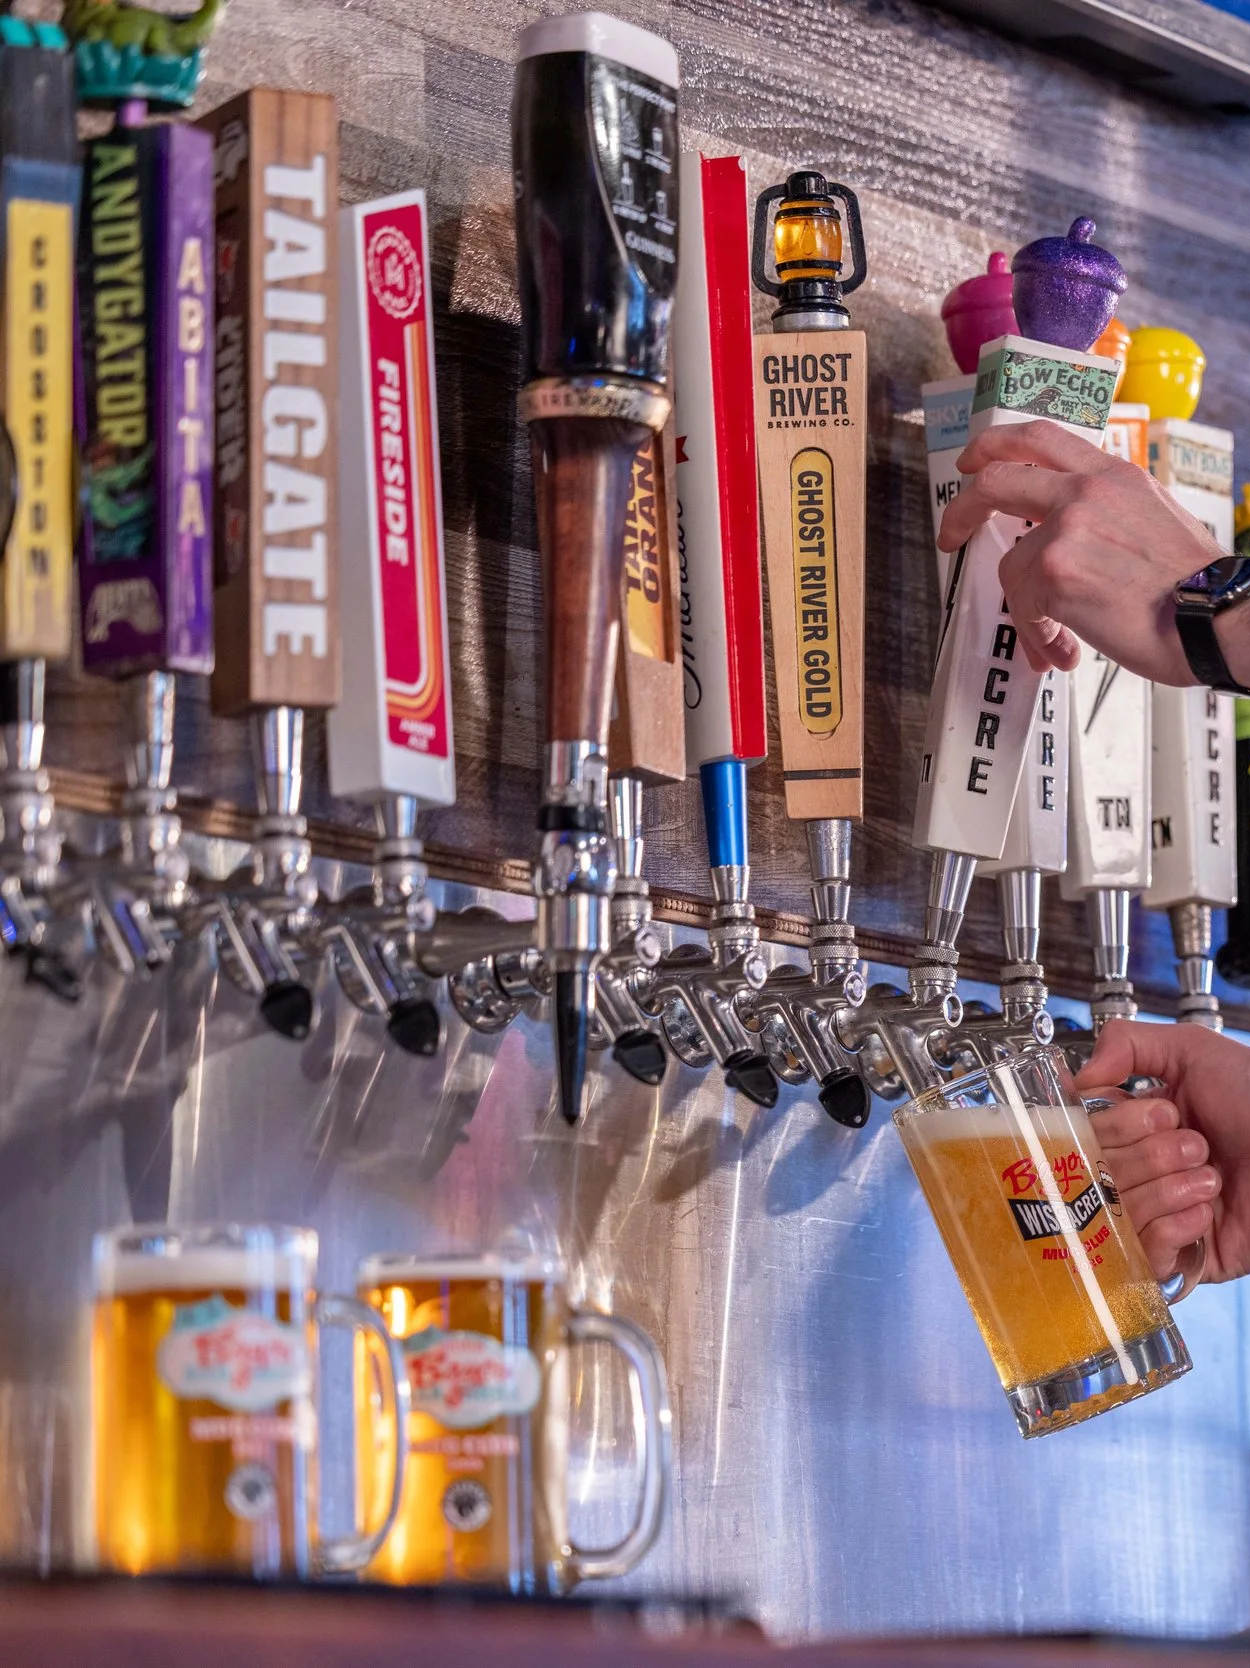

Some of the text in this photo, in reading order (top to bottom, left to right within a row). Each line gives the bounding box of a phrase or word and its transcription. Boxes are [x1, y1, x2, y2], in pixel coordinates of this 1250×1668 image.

[91, 143, 148, 448] ANDYGATOR
[177, 237, 207, 538] ABITA
[763, 353, 852, 385] GHOST
[1004, 367, 1054, 396] BOW
[1056, 367, 1109, 405] ECHO
[261, 153, 327, 658] TAILGATE
[767, 418, 855, 430] BREWING CO.
[770, 386, 849, 417] RIVER
[375, 357, 409, 568] FIRESIDE
[797, 470, 833, 718] GHOST RIVER GOLD
[967, 600, 1018, 795] ACRE
[1097, 797, 1133, 830] TN
[1016, 1186, 1101, 1236] WISACRE
[1083, 1224, 1112, 1254] CLUB
